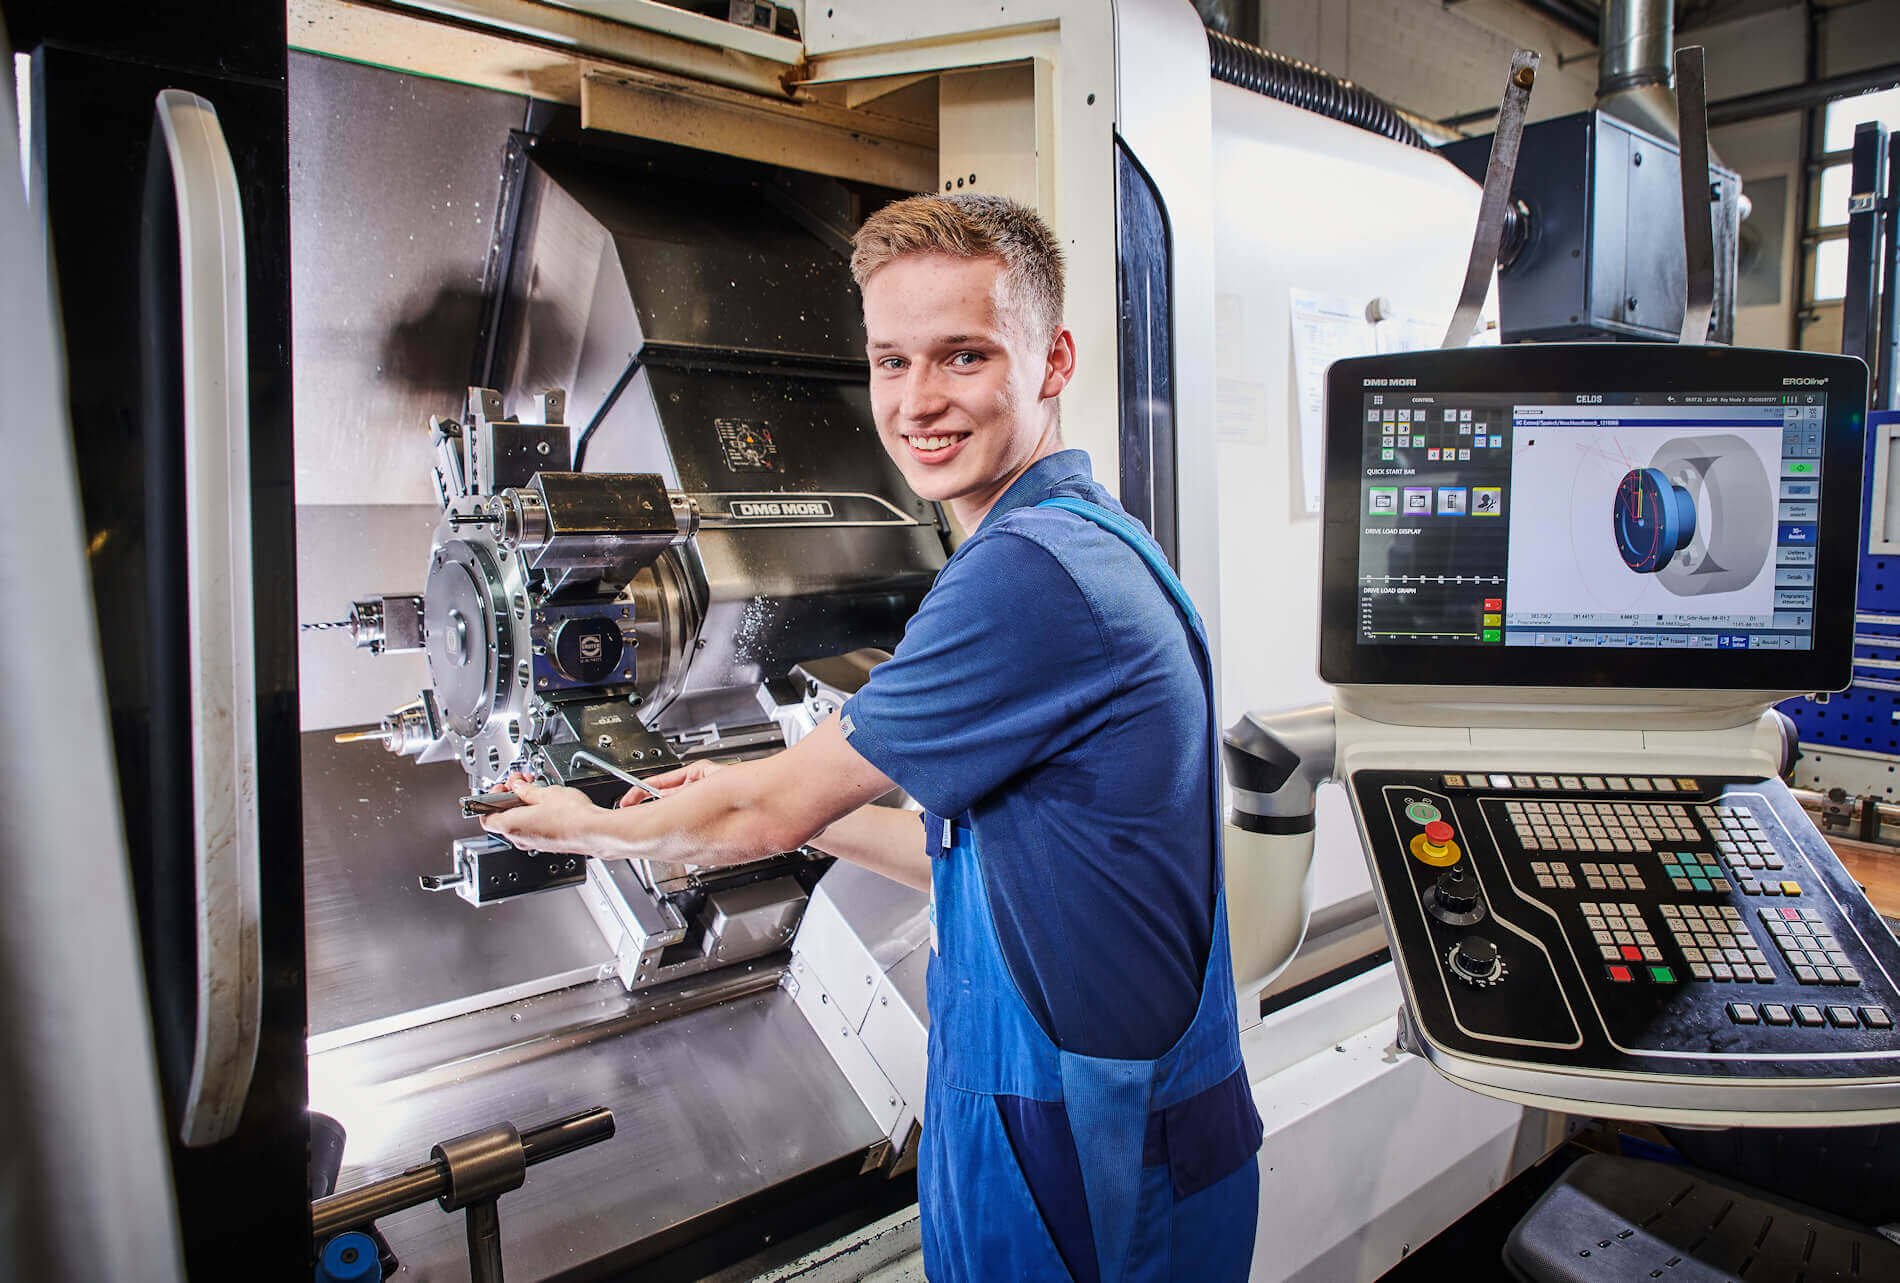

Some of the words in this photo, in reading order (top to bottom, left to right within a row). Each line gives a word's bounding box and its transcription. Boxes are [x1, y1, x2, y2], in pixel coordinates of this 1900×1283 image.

[1363, 378, 1388, 387] DMG
[1389, 378, 1417, 387] MORI
[1575, 394, 1603, 404] CELOS
[1366, 468, 1384, 476] QUICK
[740, 503, 780, 515] DMG
[781, 503, 825, 515] MORI
